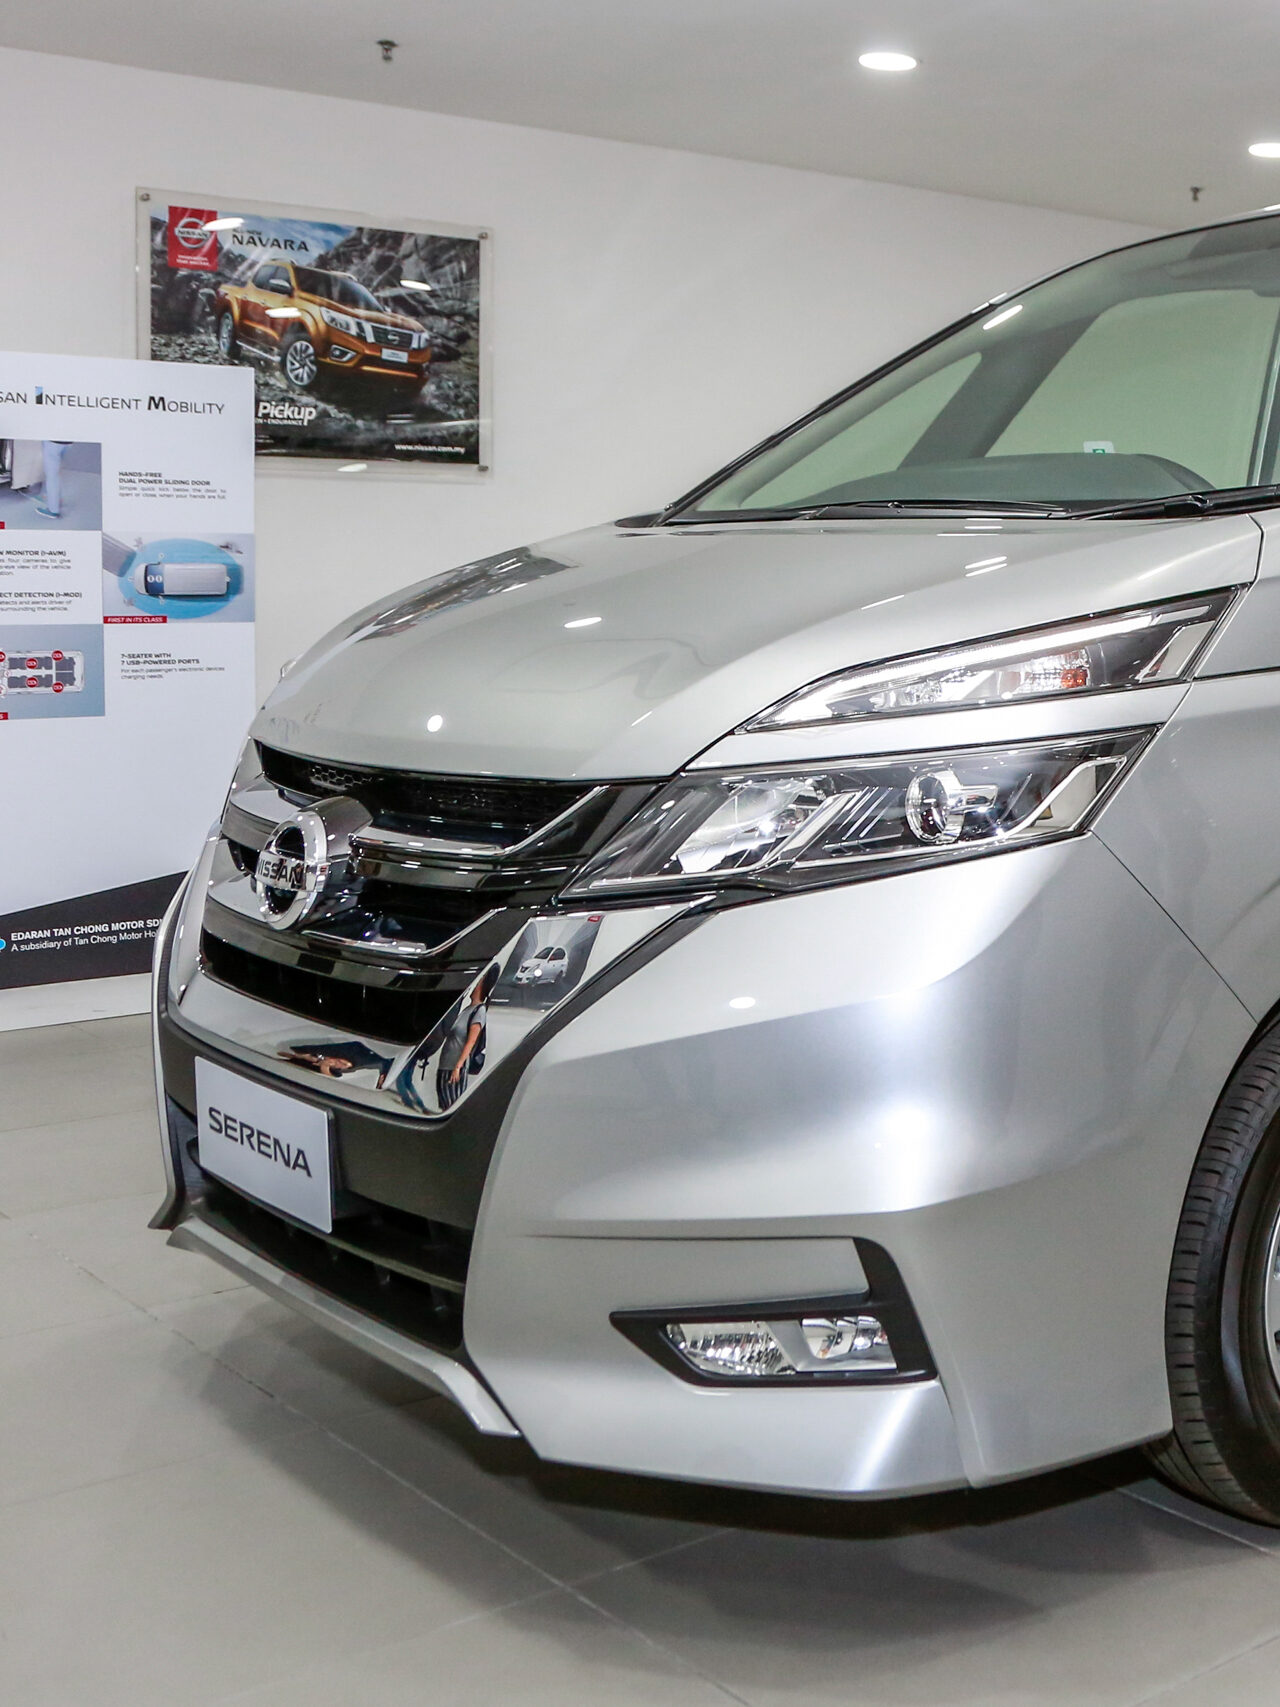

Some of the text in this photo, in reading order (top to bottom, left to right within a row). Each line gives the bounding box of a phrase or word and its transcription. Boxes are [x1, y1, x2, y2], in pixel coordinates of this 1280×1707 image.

[232, 234, 310, 252] NAVARA
[35, 386, 142, 411] INTELLIGENT
[147, 395, 225, 415] MOBILITY
[257, 401, 317, 426] Pickup
[257, 858, 305, 889] NISSAN
[11, 929, 51, 941] EDARAN
[53, 927, 72, 937] TAN
[74, 924, 109, 935] CHONG
[112, 920, 144, 931] MOTOR
[11, 943, 19, 952] A
[20, 940, 62, 951] subsidiary
[64, 938, 72, 947] of
[74, 937, 89, 946] Tan
[91, 934, 118, 945] Chong
[119, 932, 142, 942] Motor
[208, 1106, 312, 1178] SERENA
